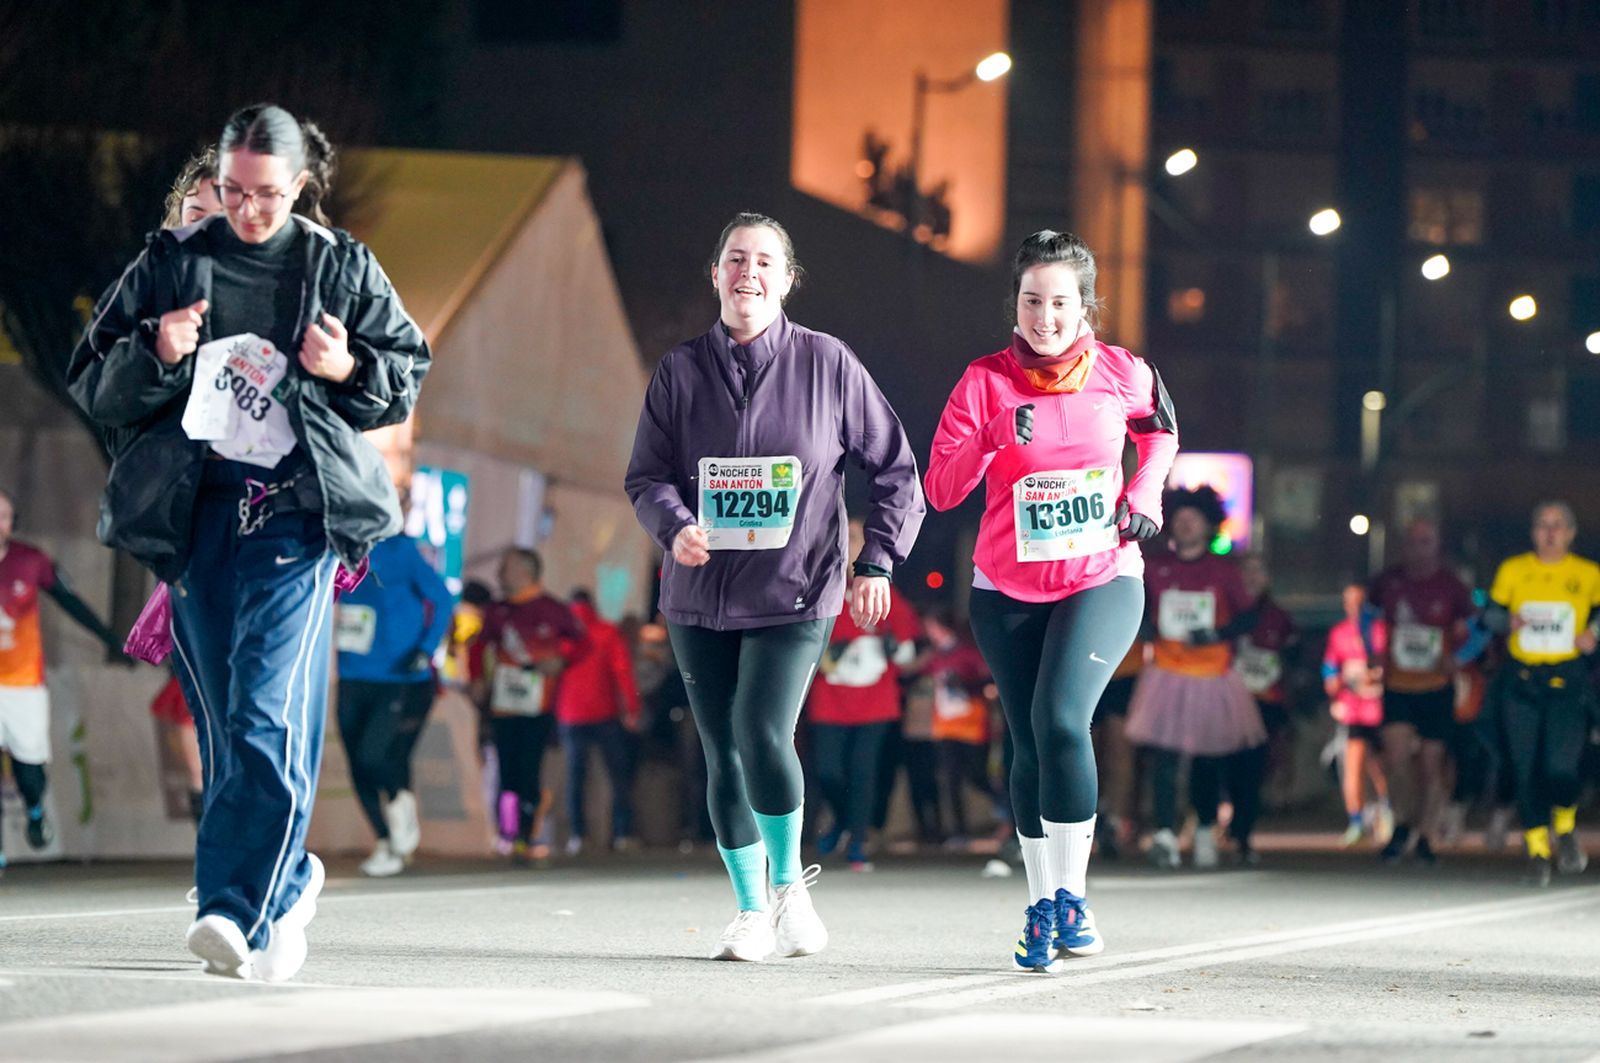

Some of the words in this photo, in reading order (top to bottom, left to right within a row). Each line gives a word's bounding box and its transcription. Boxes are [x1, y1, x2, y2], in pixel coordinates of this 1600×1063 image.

[720, 468, 748, 477] NOCHE
[751, 468, 762, 477] DE
[709, 480, 728, 489] SAN
[730, 477, 763, 489] ANTÓN
[1025, 491, 1045, 501] SAN
[712, 491, 789, 518] 12294
[1026, 492, 1104, 530] 13306
